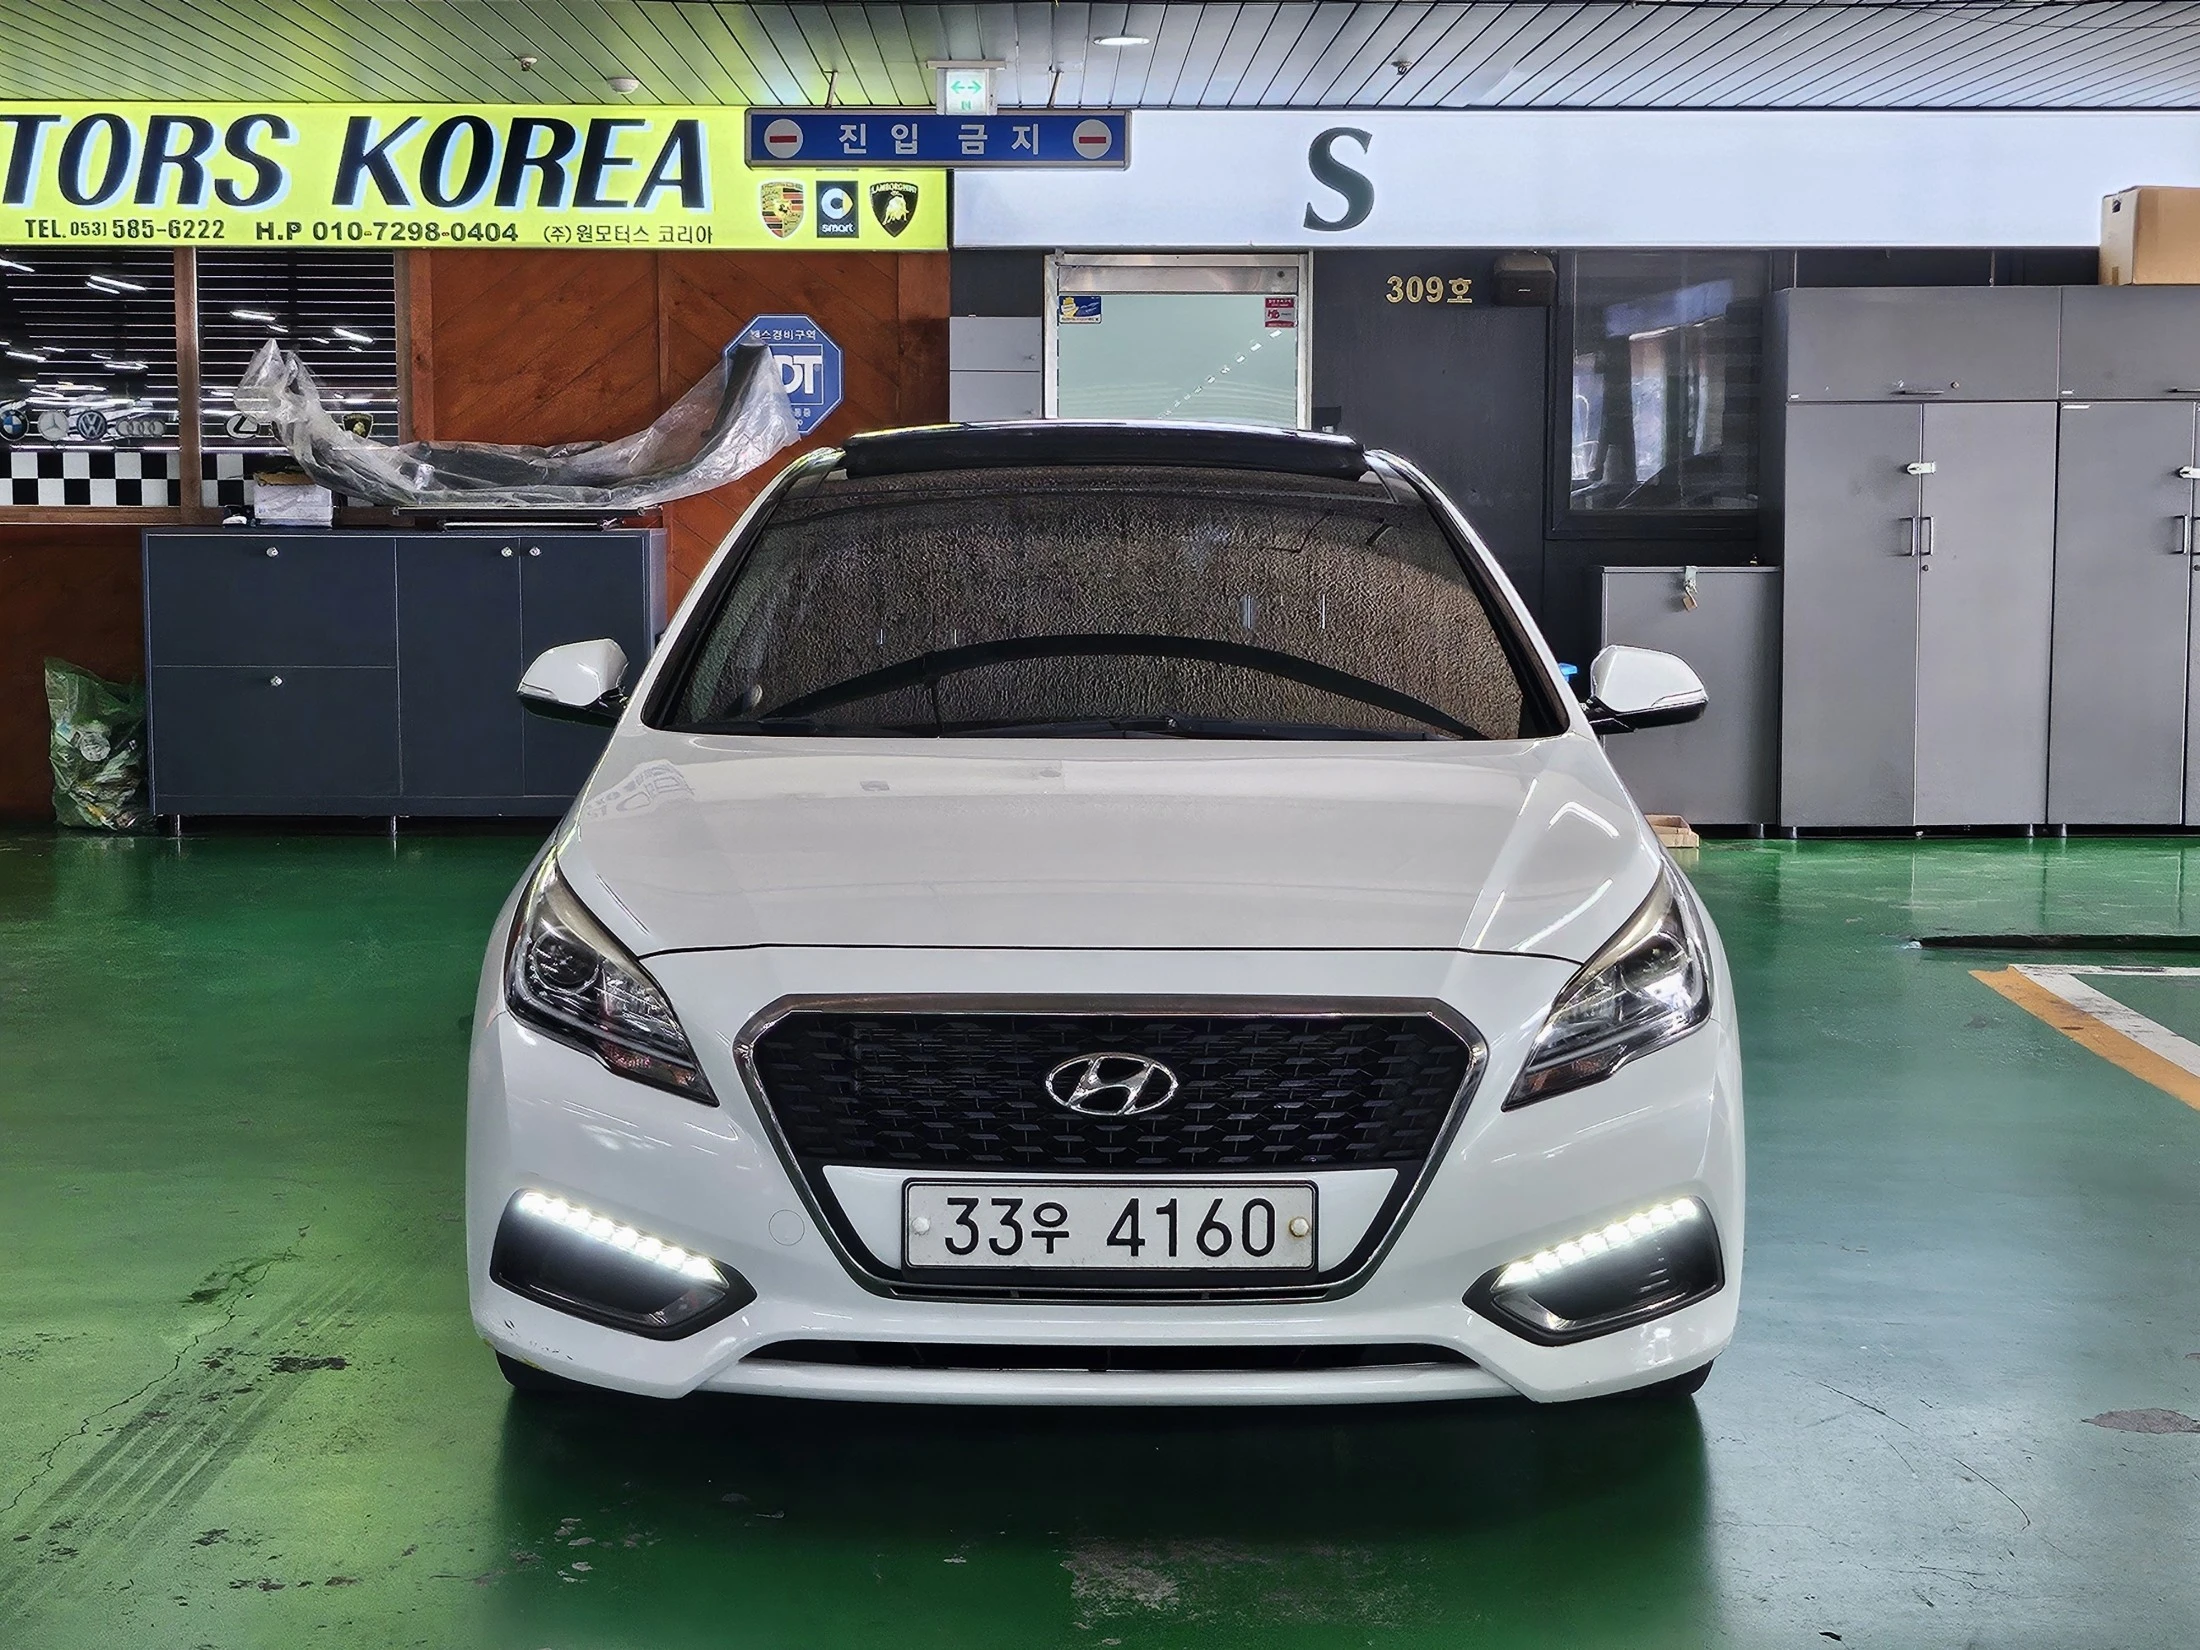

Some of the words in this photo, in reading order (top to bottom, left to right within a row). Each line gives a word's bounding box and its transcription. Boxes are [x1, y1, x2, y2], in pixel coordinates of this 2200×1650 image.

[0, 113, 292, 208] TORS
[332, 115, 705, 209] KOREA
[1303, 126, 1375, 232] S
[256, 221, 302, 241] H.P
[312, 221, 519, 242] 010-7298-0404
[658, 225, 713, 244] 코리아
[821, 222, 854, 233] smart
[1385, 275, 1473, 304] 309호
[772, 354, 823, 395] DT
[944, 1196, 1070, 1256] 33우
[1106, 1197, 1276, 1258] 4160
